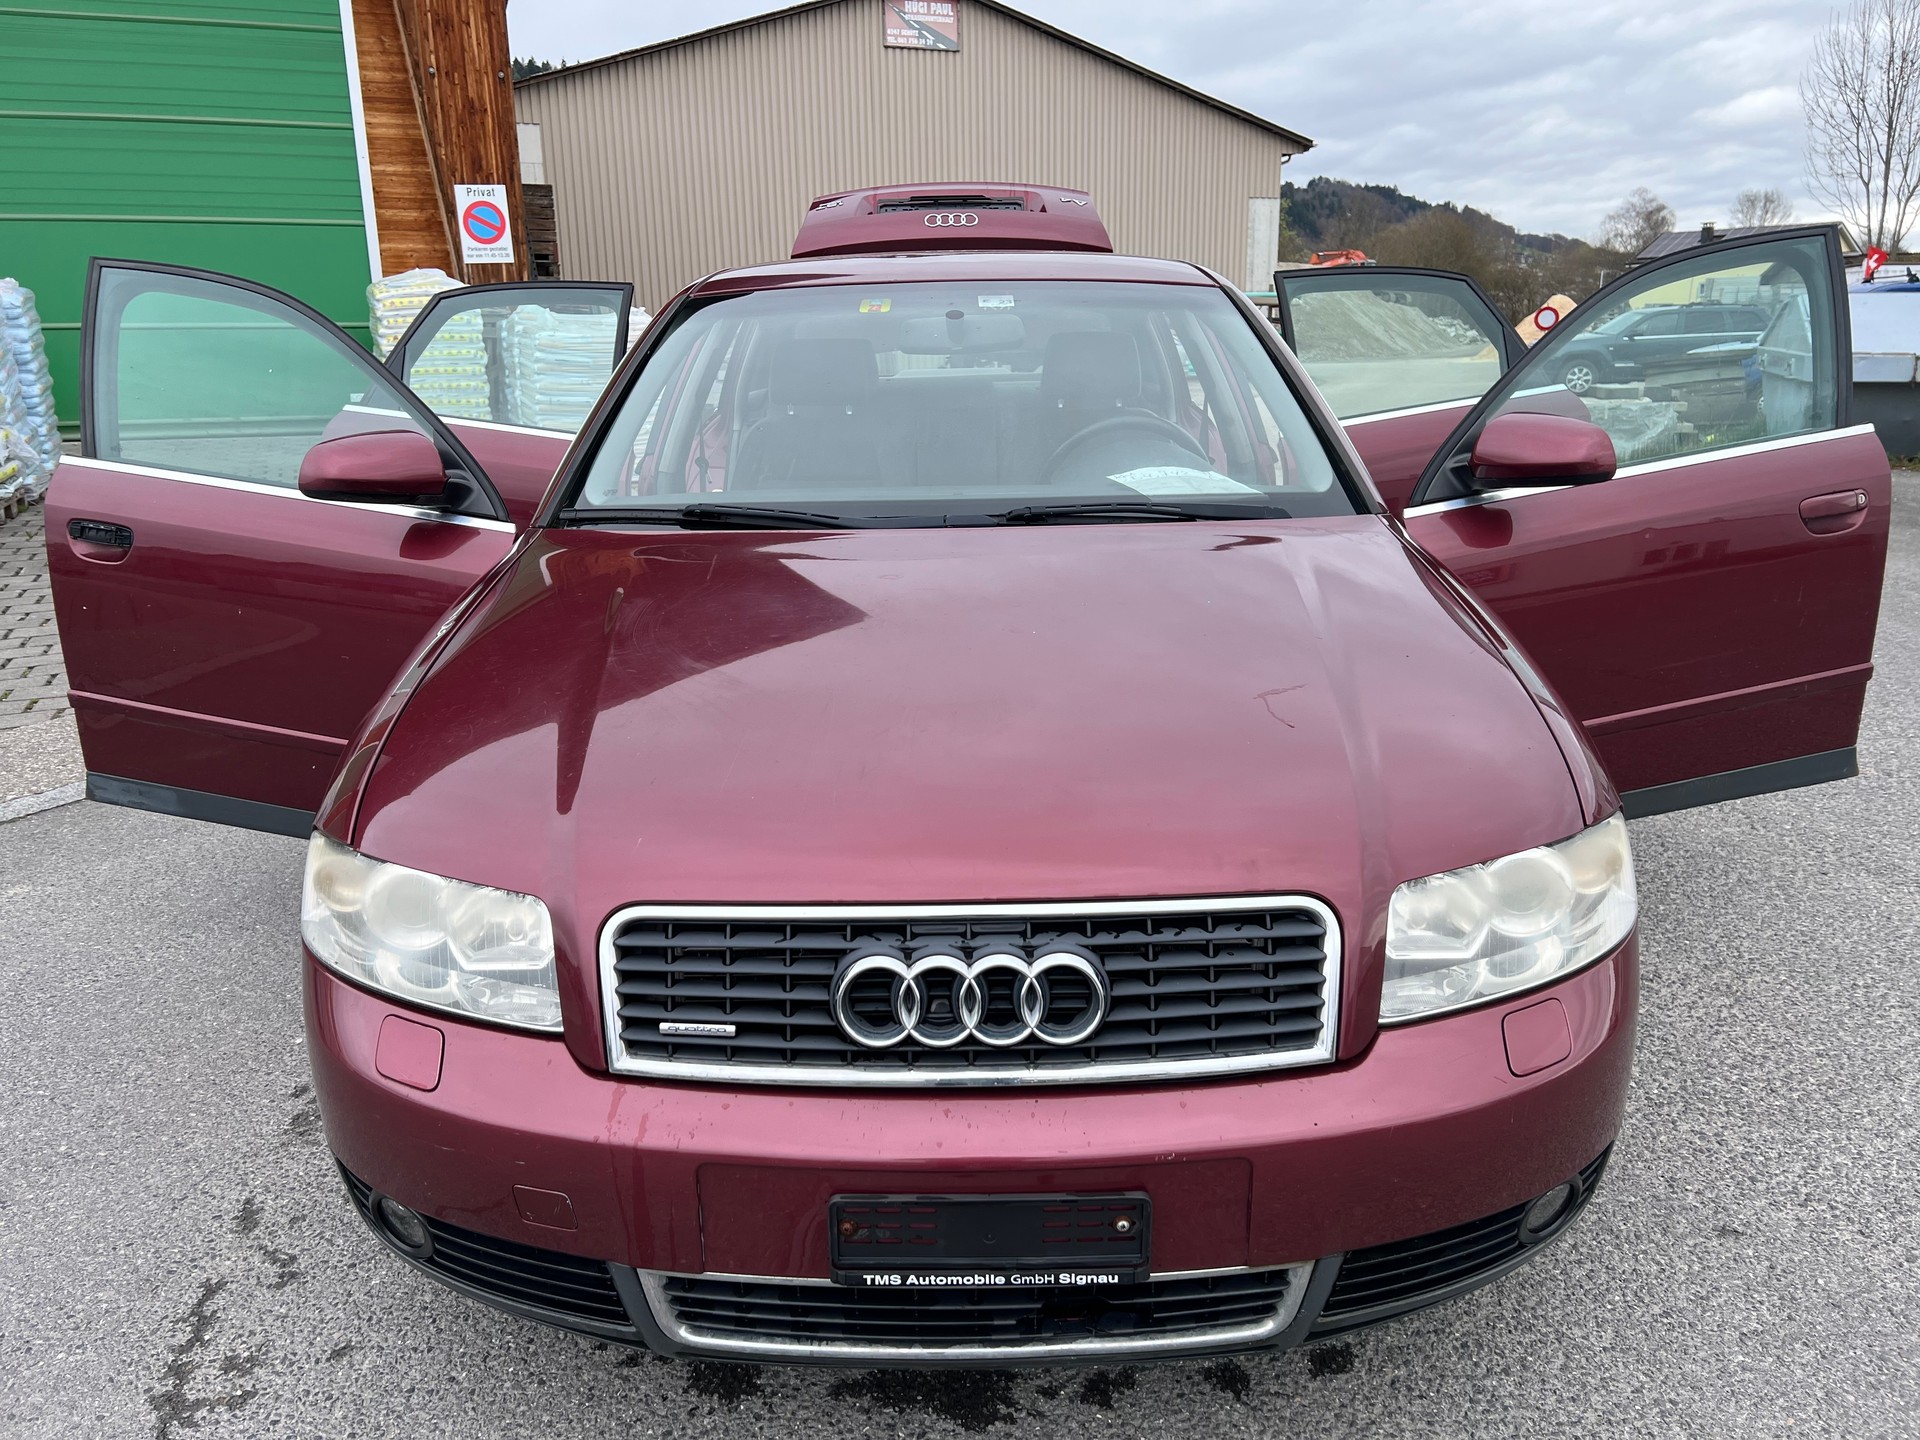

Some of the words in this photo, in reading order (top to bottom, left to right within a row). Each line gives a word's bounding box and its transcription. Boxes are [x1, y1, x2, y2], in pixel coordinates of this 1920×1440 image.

[930, 3, 954, 15] PAUL
[466, 187, 496, 197] Privat
[667, 1025, 727, 1033] quattro
[863, 1274, 902, 1285] TMS
[905, 1274, 1006, 1285] Automobile
[1010, 1273, 1055, 1285] GmbH
[1058, 1273, 1119, 1285] Signau
